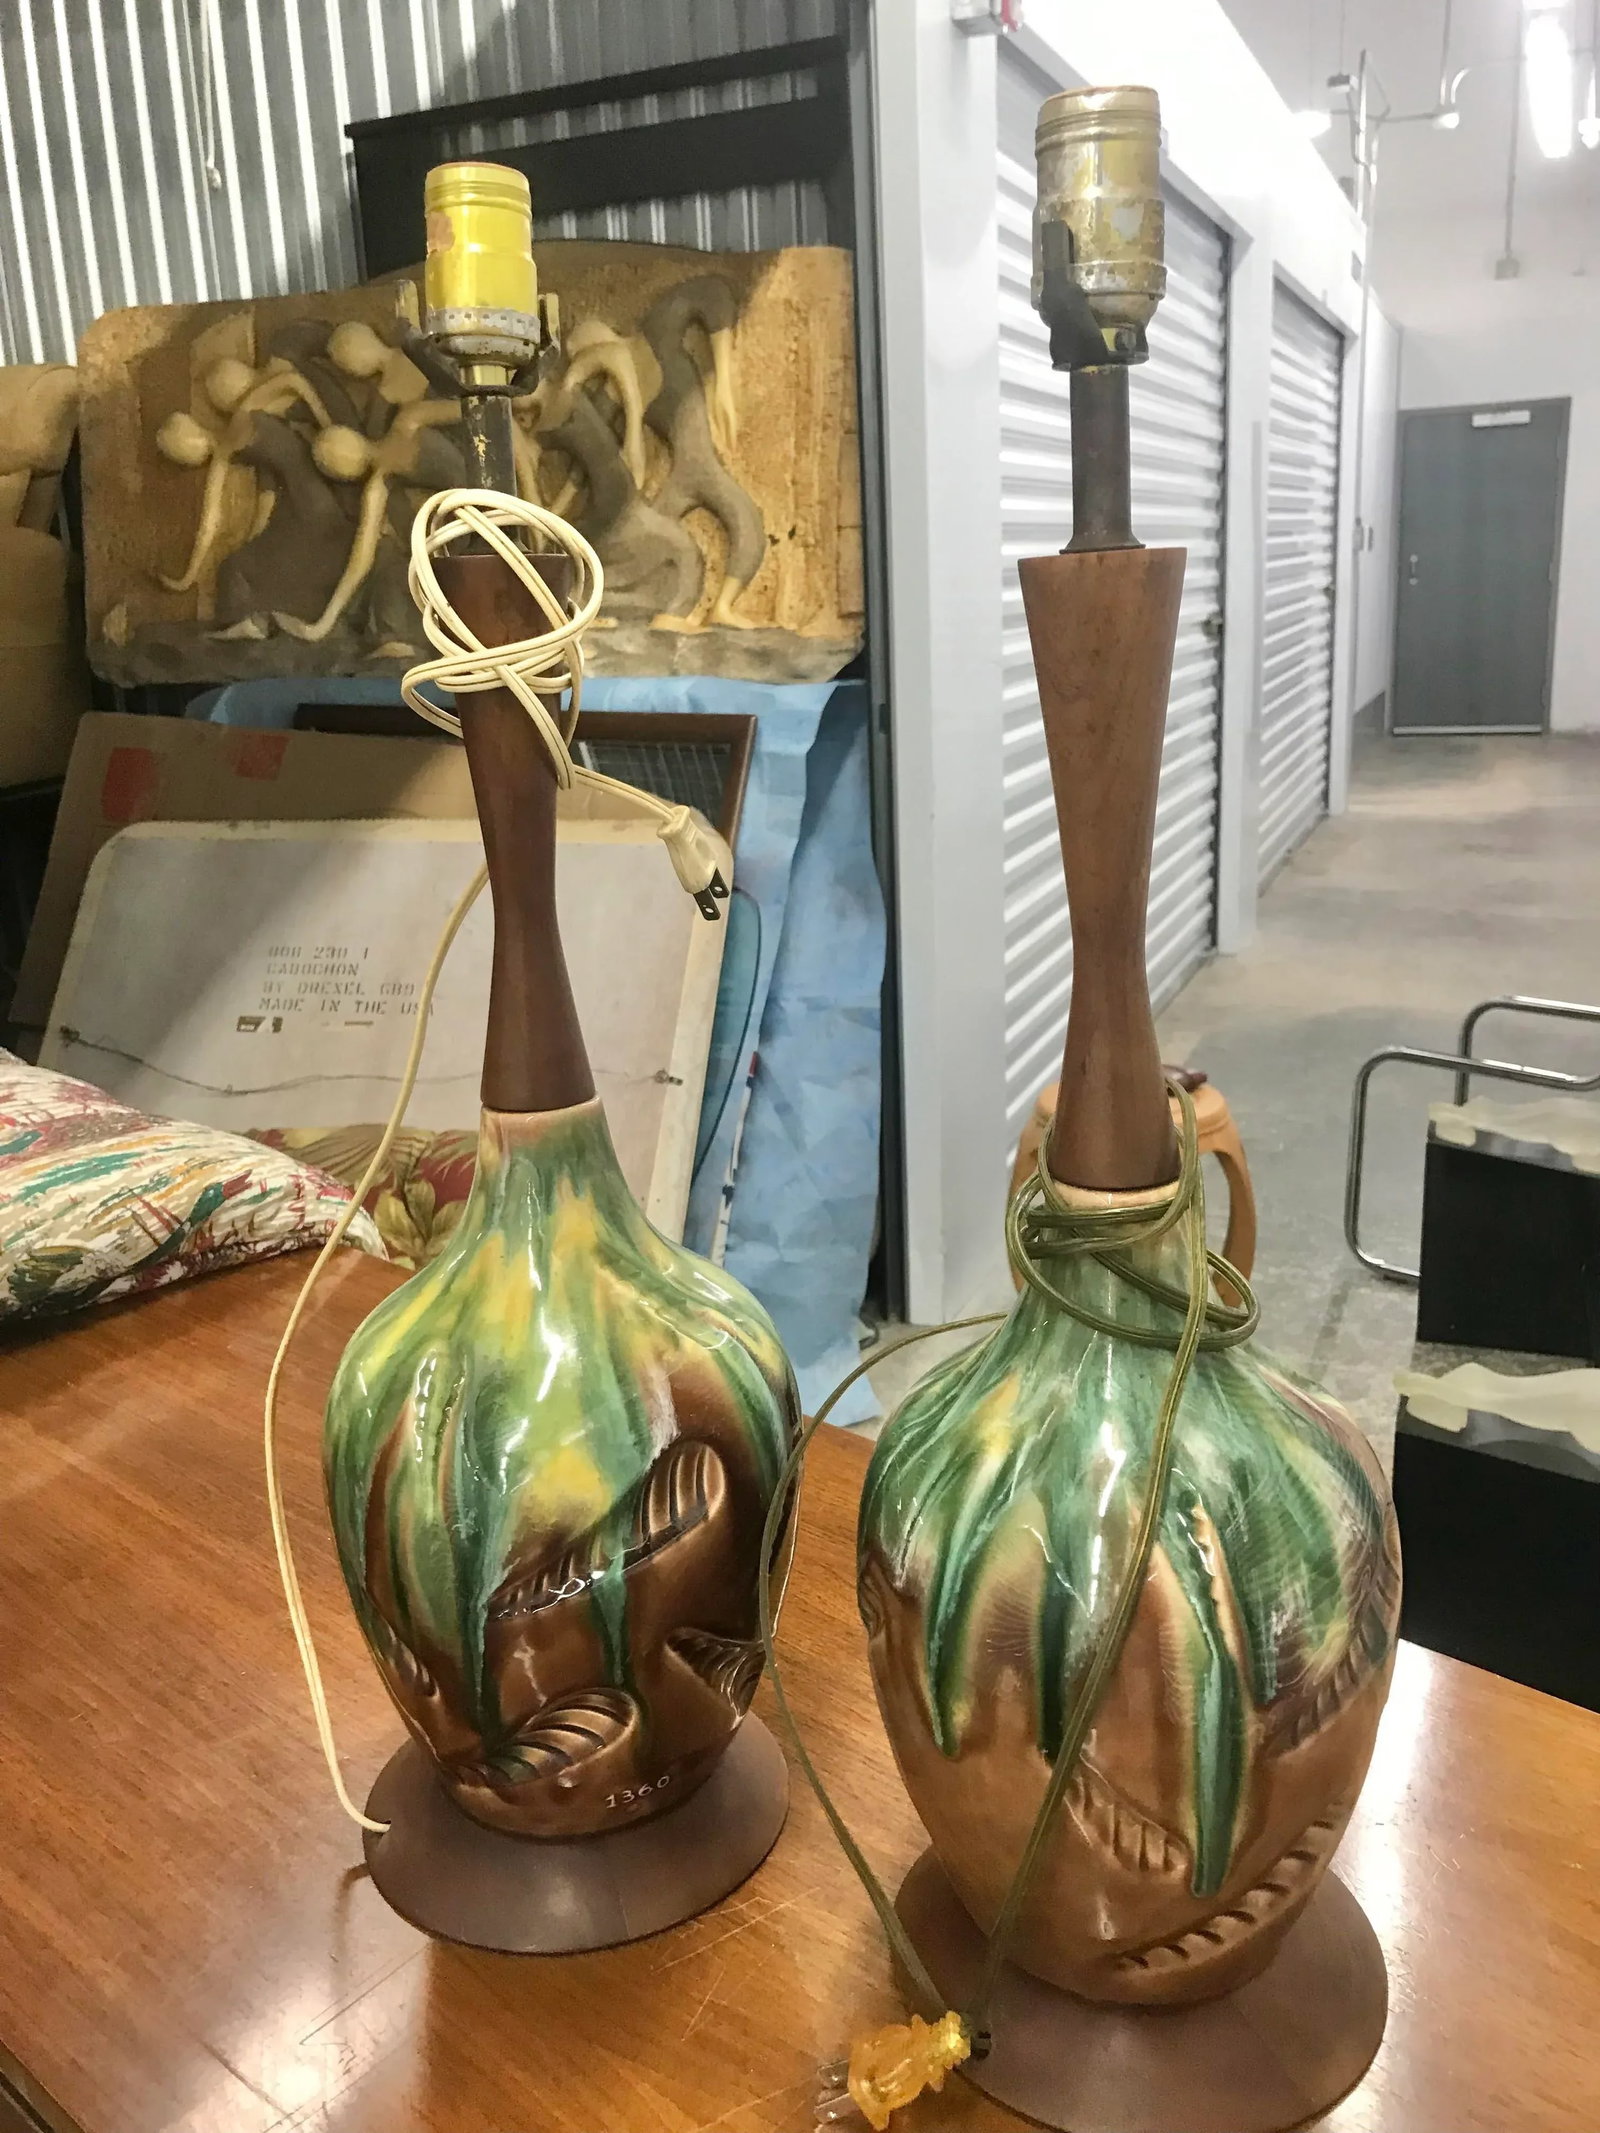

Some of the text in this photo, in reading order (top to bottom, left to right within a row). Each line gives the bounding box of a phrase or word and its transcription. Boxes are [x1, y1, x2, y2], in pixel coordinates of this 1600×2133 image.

[267, 962, 360, 977] CABOCHON
[262, 980, 285, 994] BY
[297, 981, 366, 995] DREXEL
[258, 997, 306, 1012] MADE
[320, 999, 341, 1013] IN
[355, 999, 388, 1015] THE
[605, 1775, 670, 1809] 1360
